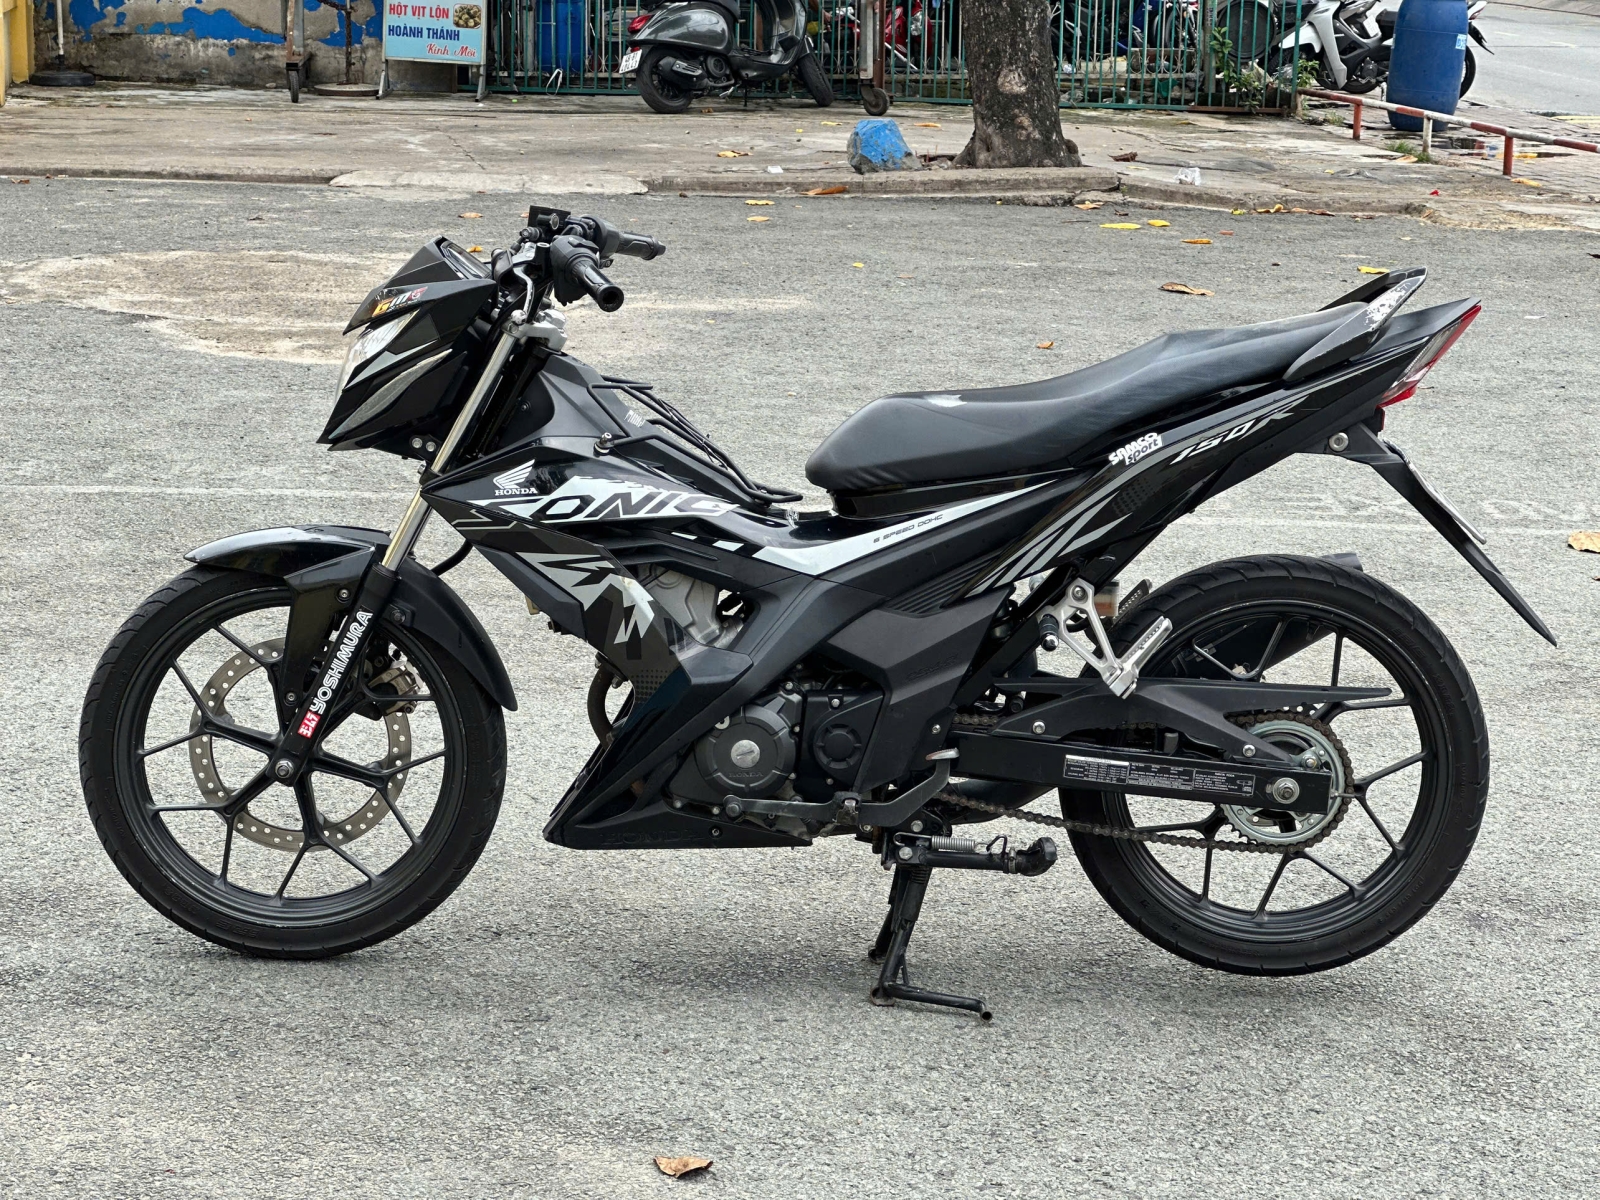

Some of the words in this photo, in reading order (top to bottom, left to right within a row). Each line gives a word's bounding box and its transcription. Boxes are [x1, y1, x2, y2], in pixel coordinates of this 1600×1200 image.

[389, 2, 408, 18] HỘT
[411, 5, 427, 19] VỊT
[429, 5, 449, 21] LỘN
[388, 23, 423, 39] HOÀNH
[426, 26, 460, 41] THÁNH
[1108, 432, 1158, 466] SAMCO
[494, 487, 538, 496] HONDA
[882, 524, 915, 541] SPEED
[309, 611, 373, 715] YOSHIMURA
